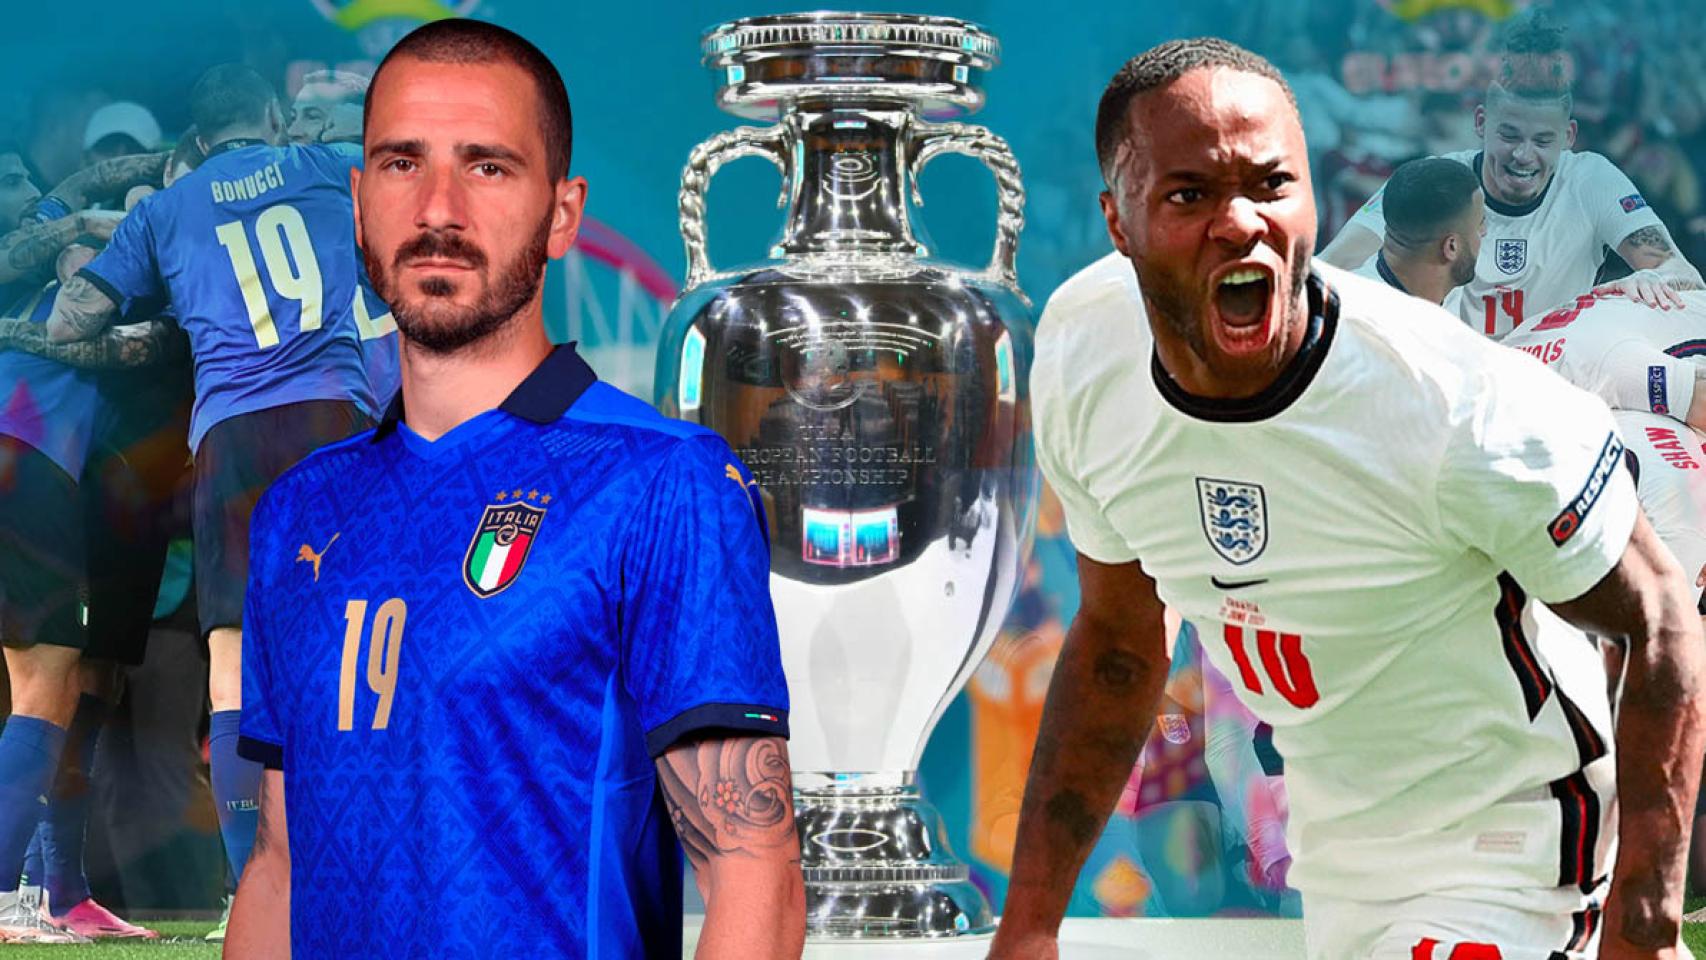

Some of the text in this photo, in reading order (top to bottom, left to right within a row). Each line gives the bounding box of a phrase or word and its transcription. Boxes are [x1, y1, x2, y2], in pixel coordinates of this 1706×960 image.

[211, 162, 284, 203] BONUCCI
[215, 204, 323, 350] 19
[1482, 289, 1524, 335] 14
[738, 447, 937, 464] UROPEAN FOOTBALL
[1644, 427, 1700, 470] SHAW
[487, 511, 539, 527] ITALIA
[338, 597, 407, 731] 19
[1224, 624, 1320, 709] 10
